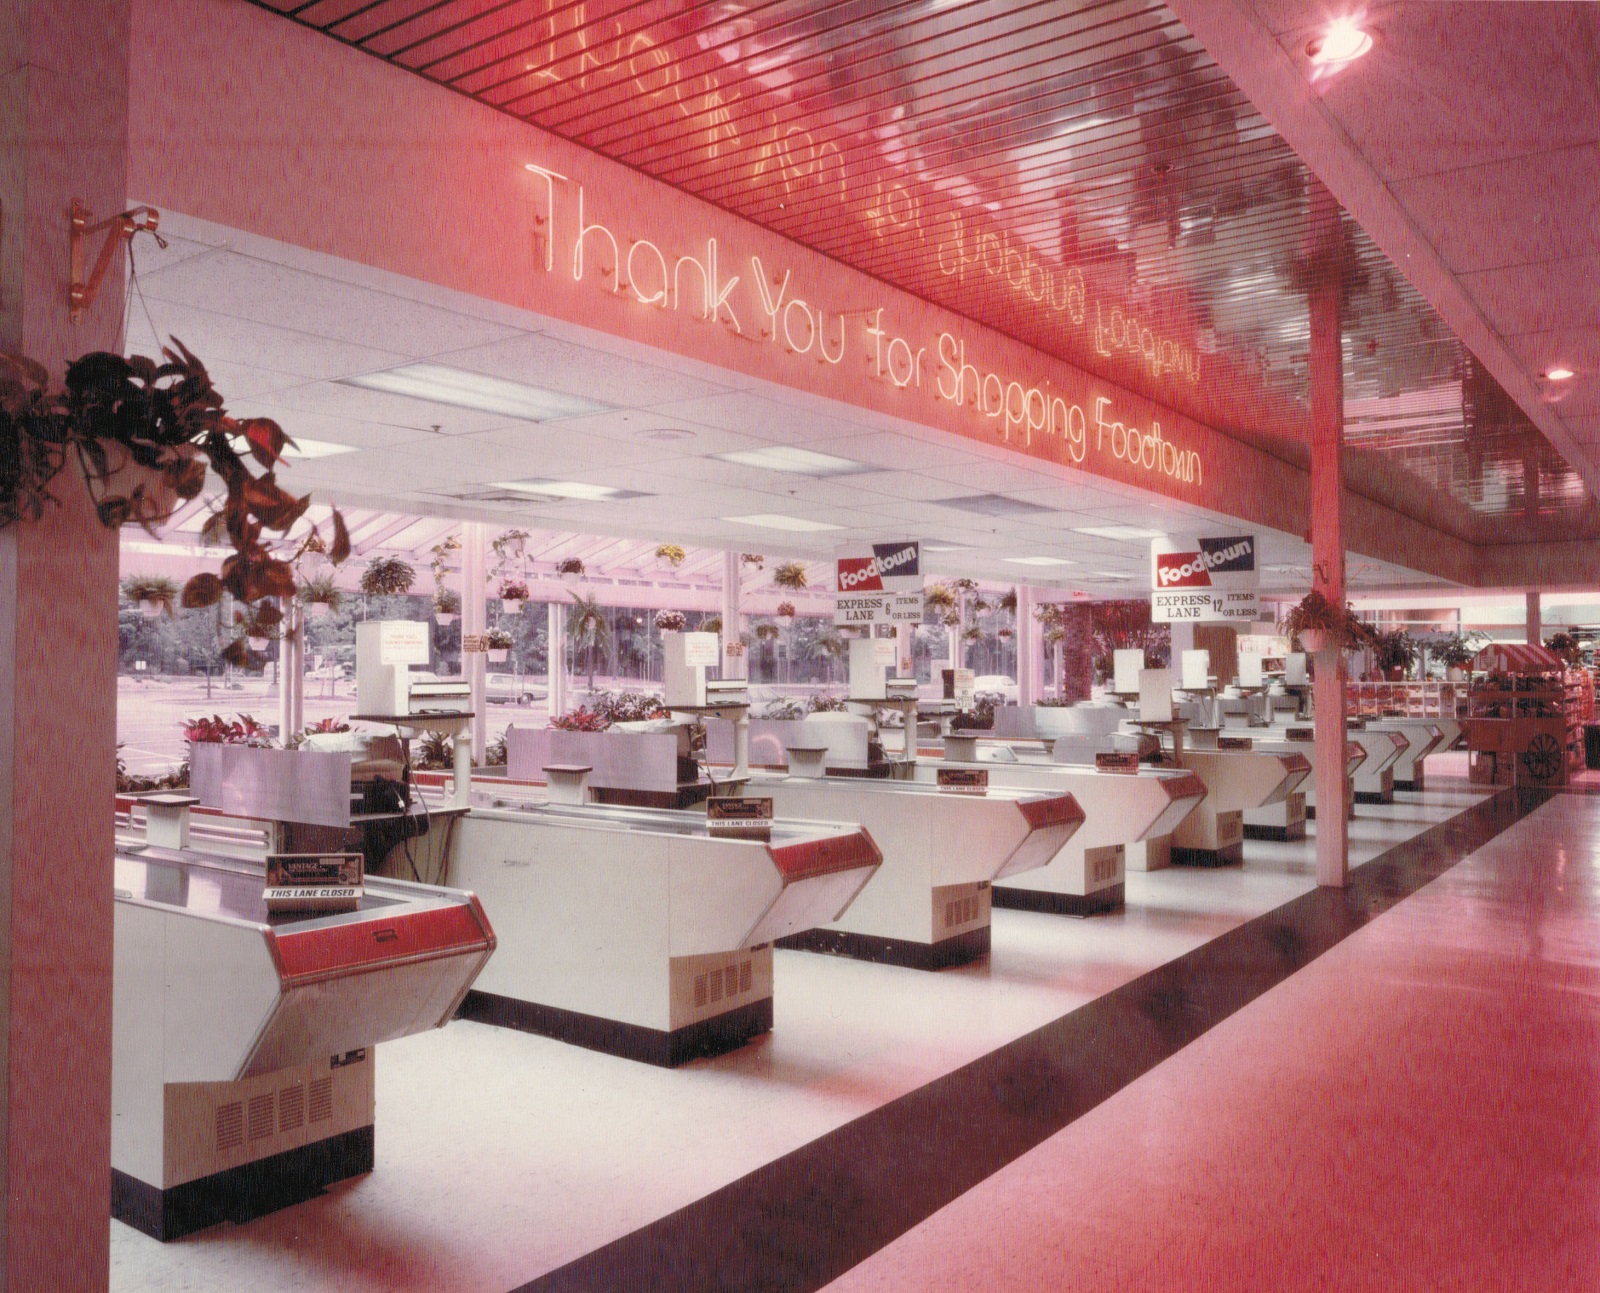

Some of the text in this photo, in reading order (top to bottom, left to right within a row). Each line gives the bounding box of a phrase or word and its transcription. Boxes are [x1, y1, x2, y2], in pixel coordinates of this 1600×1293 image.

[525, 163, 1202, 486] Thank You for Shopping Foodtown
[896, 597, 919, 605] ITEMS
[1156, 594, 1211, 607] EXPRESS
[1227, 593, 1255, 602] ITEMS
[837, 598, 883, 610] EXPRESS
[885, 602, 891, 616] 6
[1212, 598, 1223, 612] 12
[846, 610, 874, 621] LANE
[892, 611, 921, 620] OR LESS
[1167, 607, 1201, 618] LANE
[1222, 608, 1257, 617] OR LESS
[293, 889, 319, 897] LANE
[320, 889, 355, 897] CLOSED
